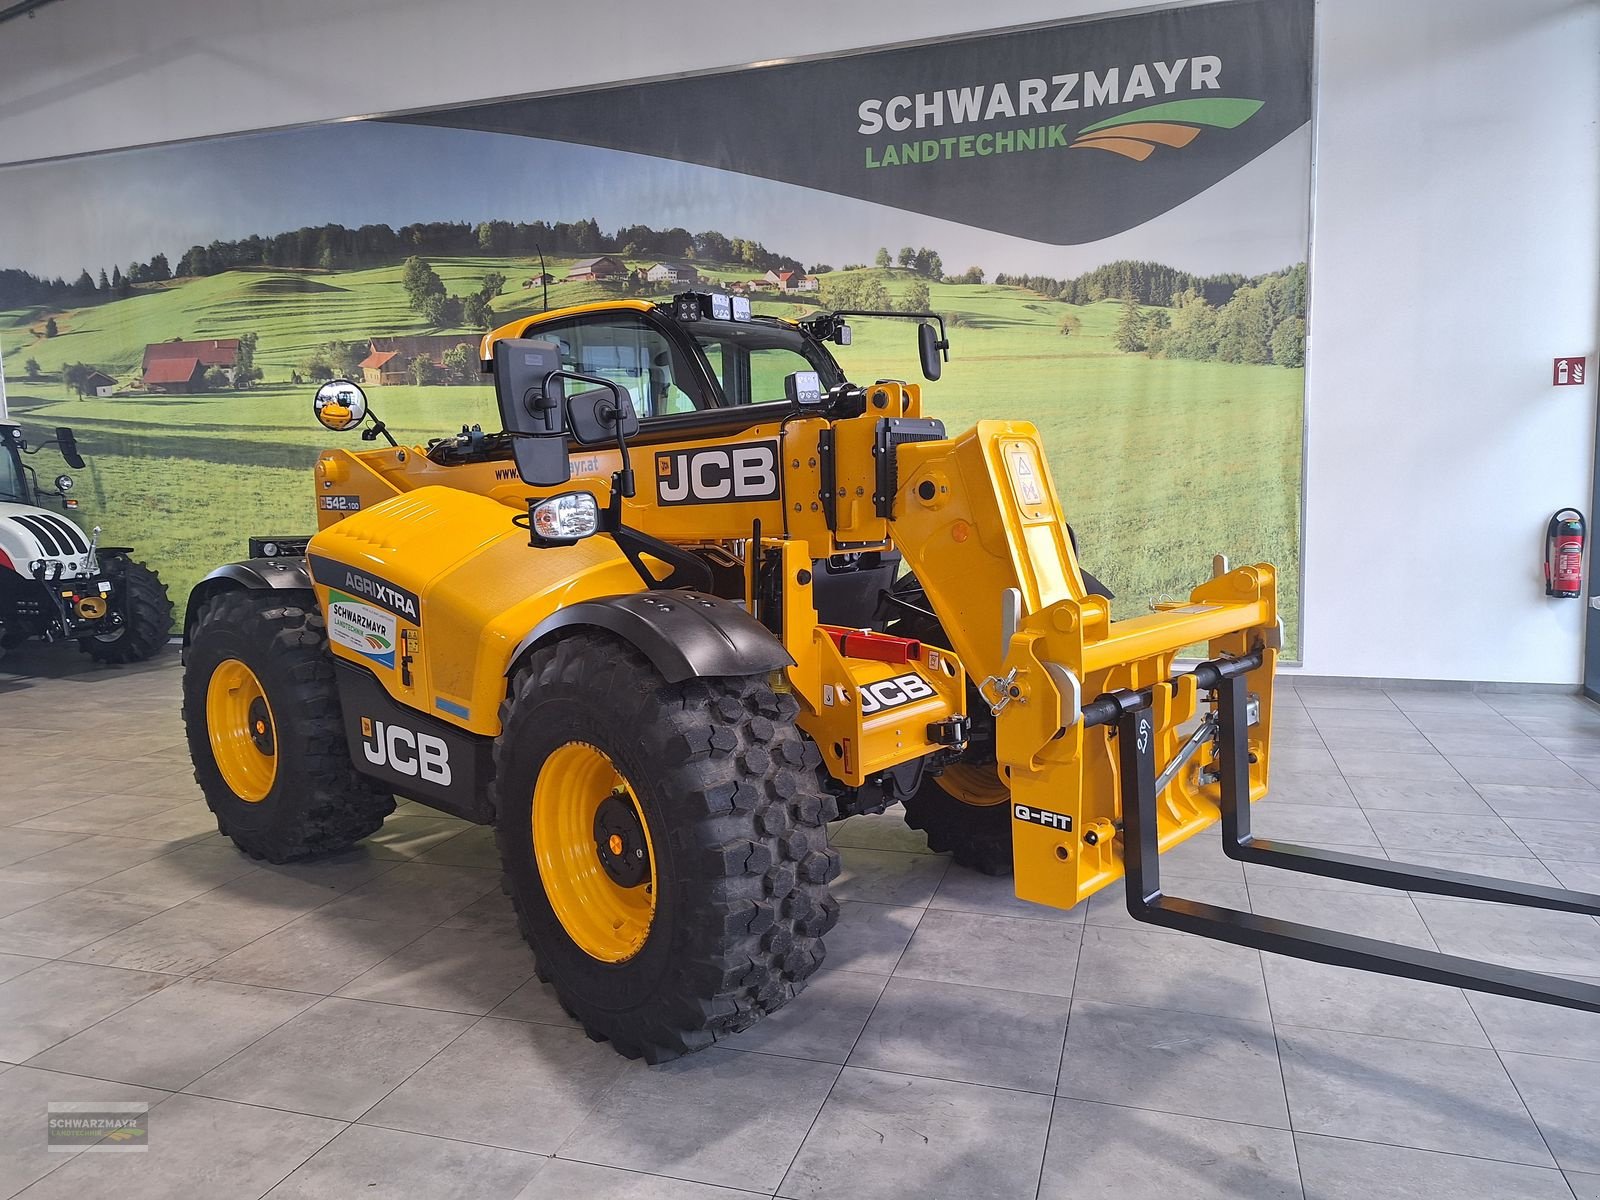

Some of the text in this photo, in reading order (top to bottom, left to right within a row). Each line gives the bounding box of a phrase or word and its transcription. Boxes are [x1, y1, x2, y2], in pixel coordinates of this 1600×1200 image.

[857, 55, 1223, 135] SCHWARZMAYR
[865, 124, 1068, 169] LANDTECHNIK
[659, 446, 776, 502] JCB
[345, 571, 417, 619] AGRIXTRA
[333, 604, 387, 636] SCHWARZMAYR
[861, 674, 933, 714] JCB
[363, 720, 452, 787] JCB
[1015, 805, 1071, 830] Q-FIT
